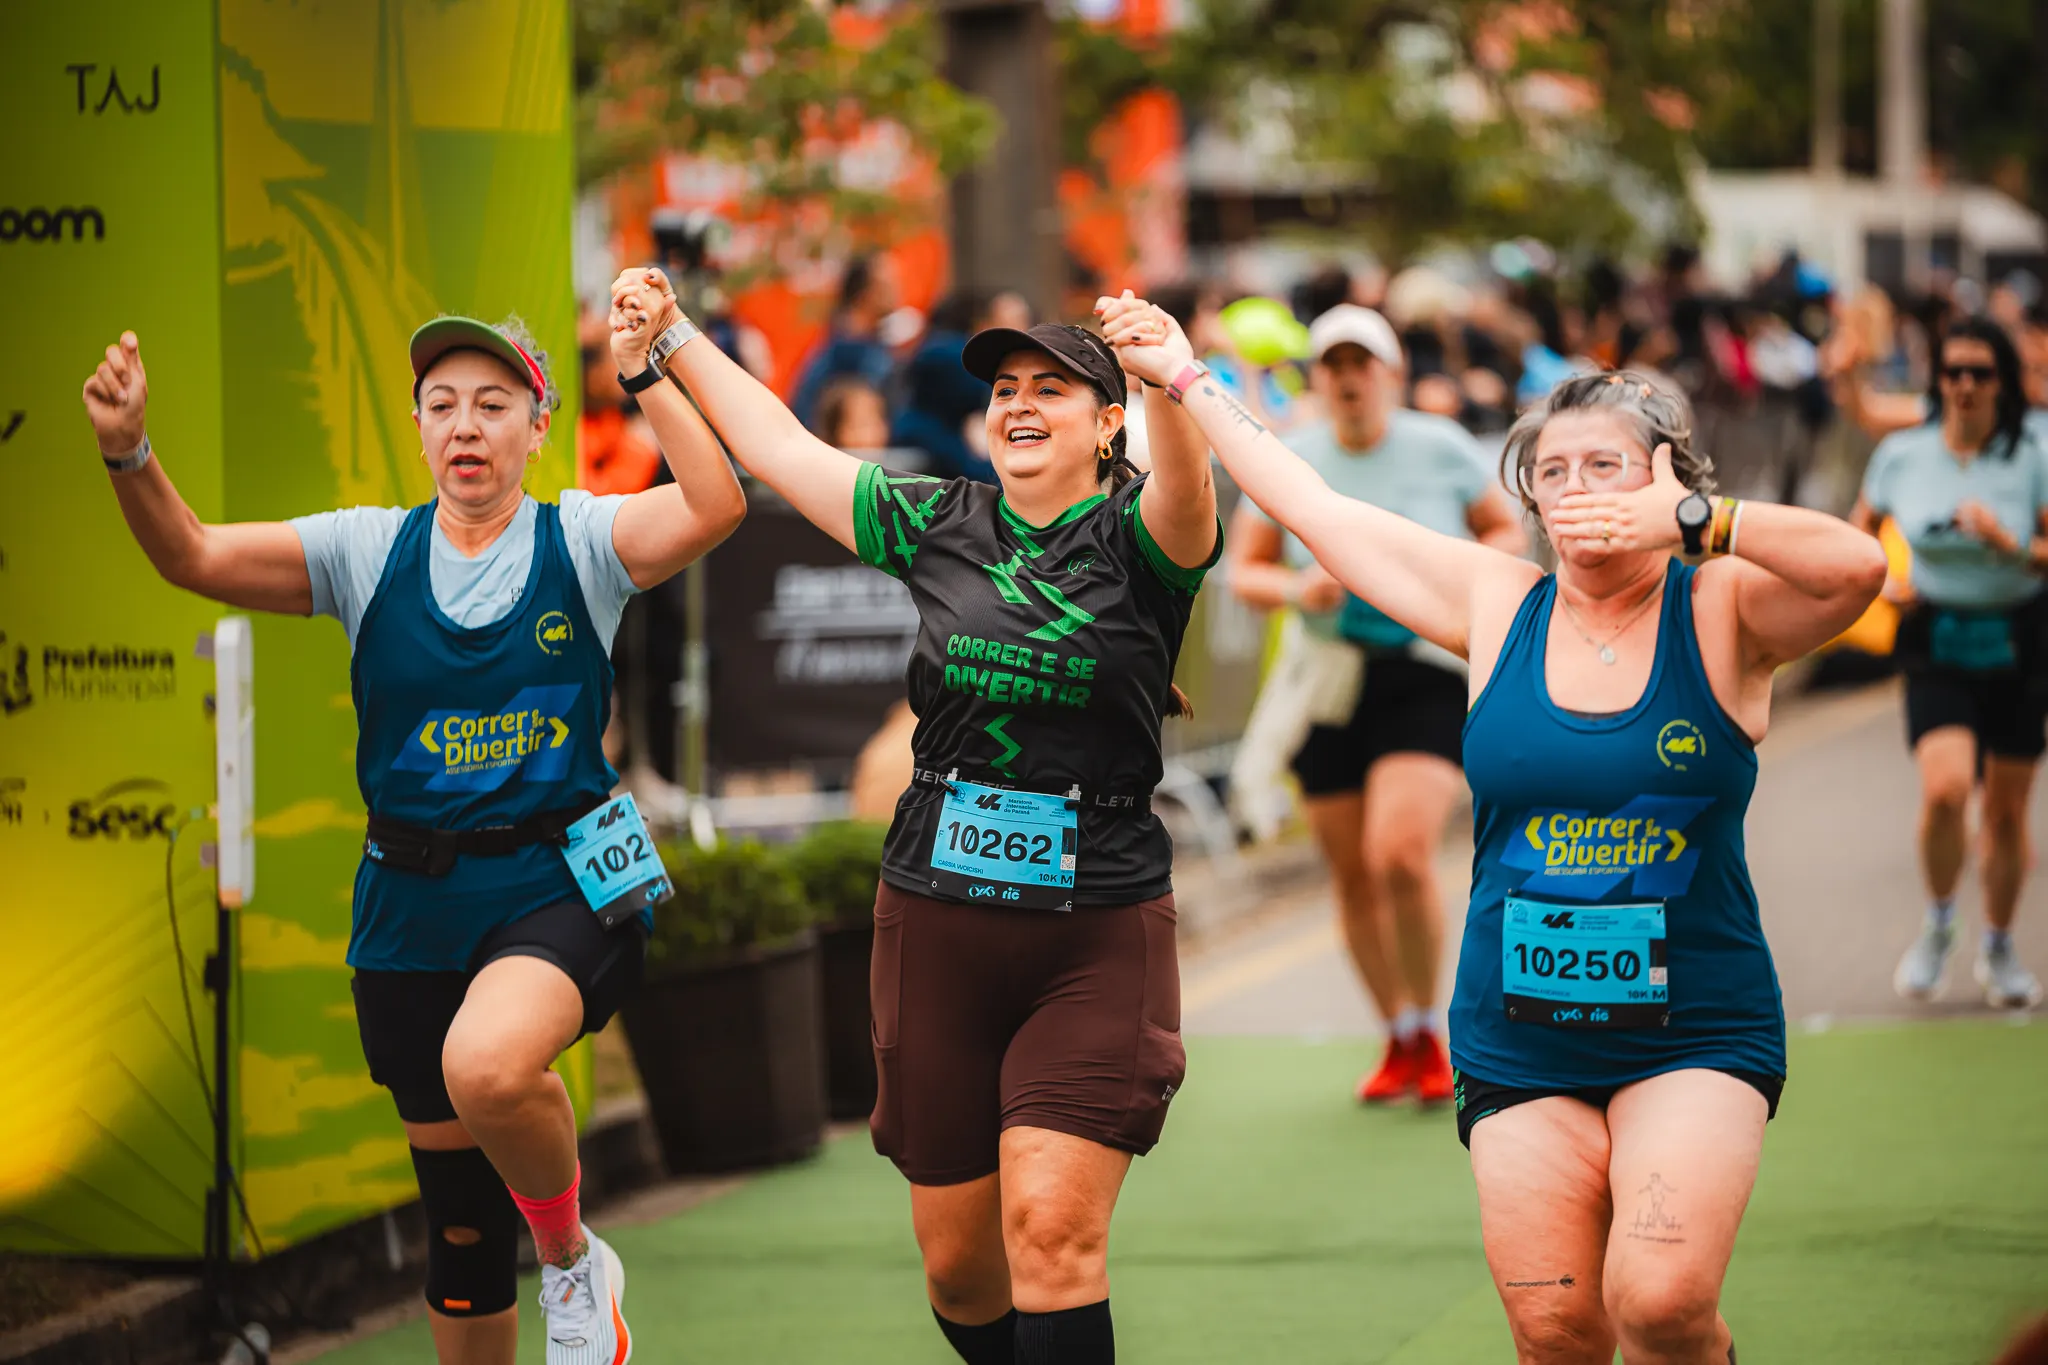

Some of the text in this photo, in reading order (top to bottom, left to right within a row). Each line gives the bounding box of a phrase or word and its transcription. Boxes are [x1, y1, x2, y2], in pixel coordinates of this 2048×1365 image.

[43, 645, 175, 670] Prefeitura
[946, 634, 1097, 680] CORRER E SE
[944, 664, 1092, 709] DIVERTIR
[443, 710, 529, 741] Correr
[444, 728, 546, 768] Divertir
[1006, 803, 1040, 811] Internacional
[1549, 813, 1643, 839] Correr
[584, 833, 651, 883] 102
[947, 821, 1053, 866] 10262
[1545, 837, 1663, 867] Divertir
[937, 859, 957, 869] CASSIA
[1038, 873, 1073, 885] 10K M
[1513, 943, 1641, 982] 10250
[1627, 989, 1667, 1000] 10K M
